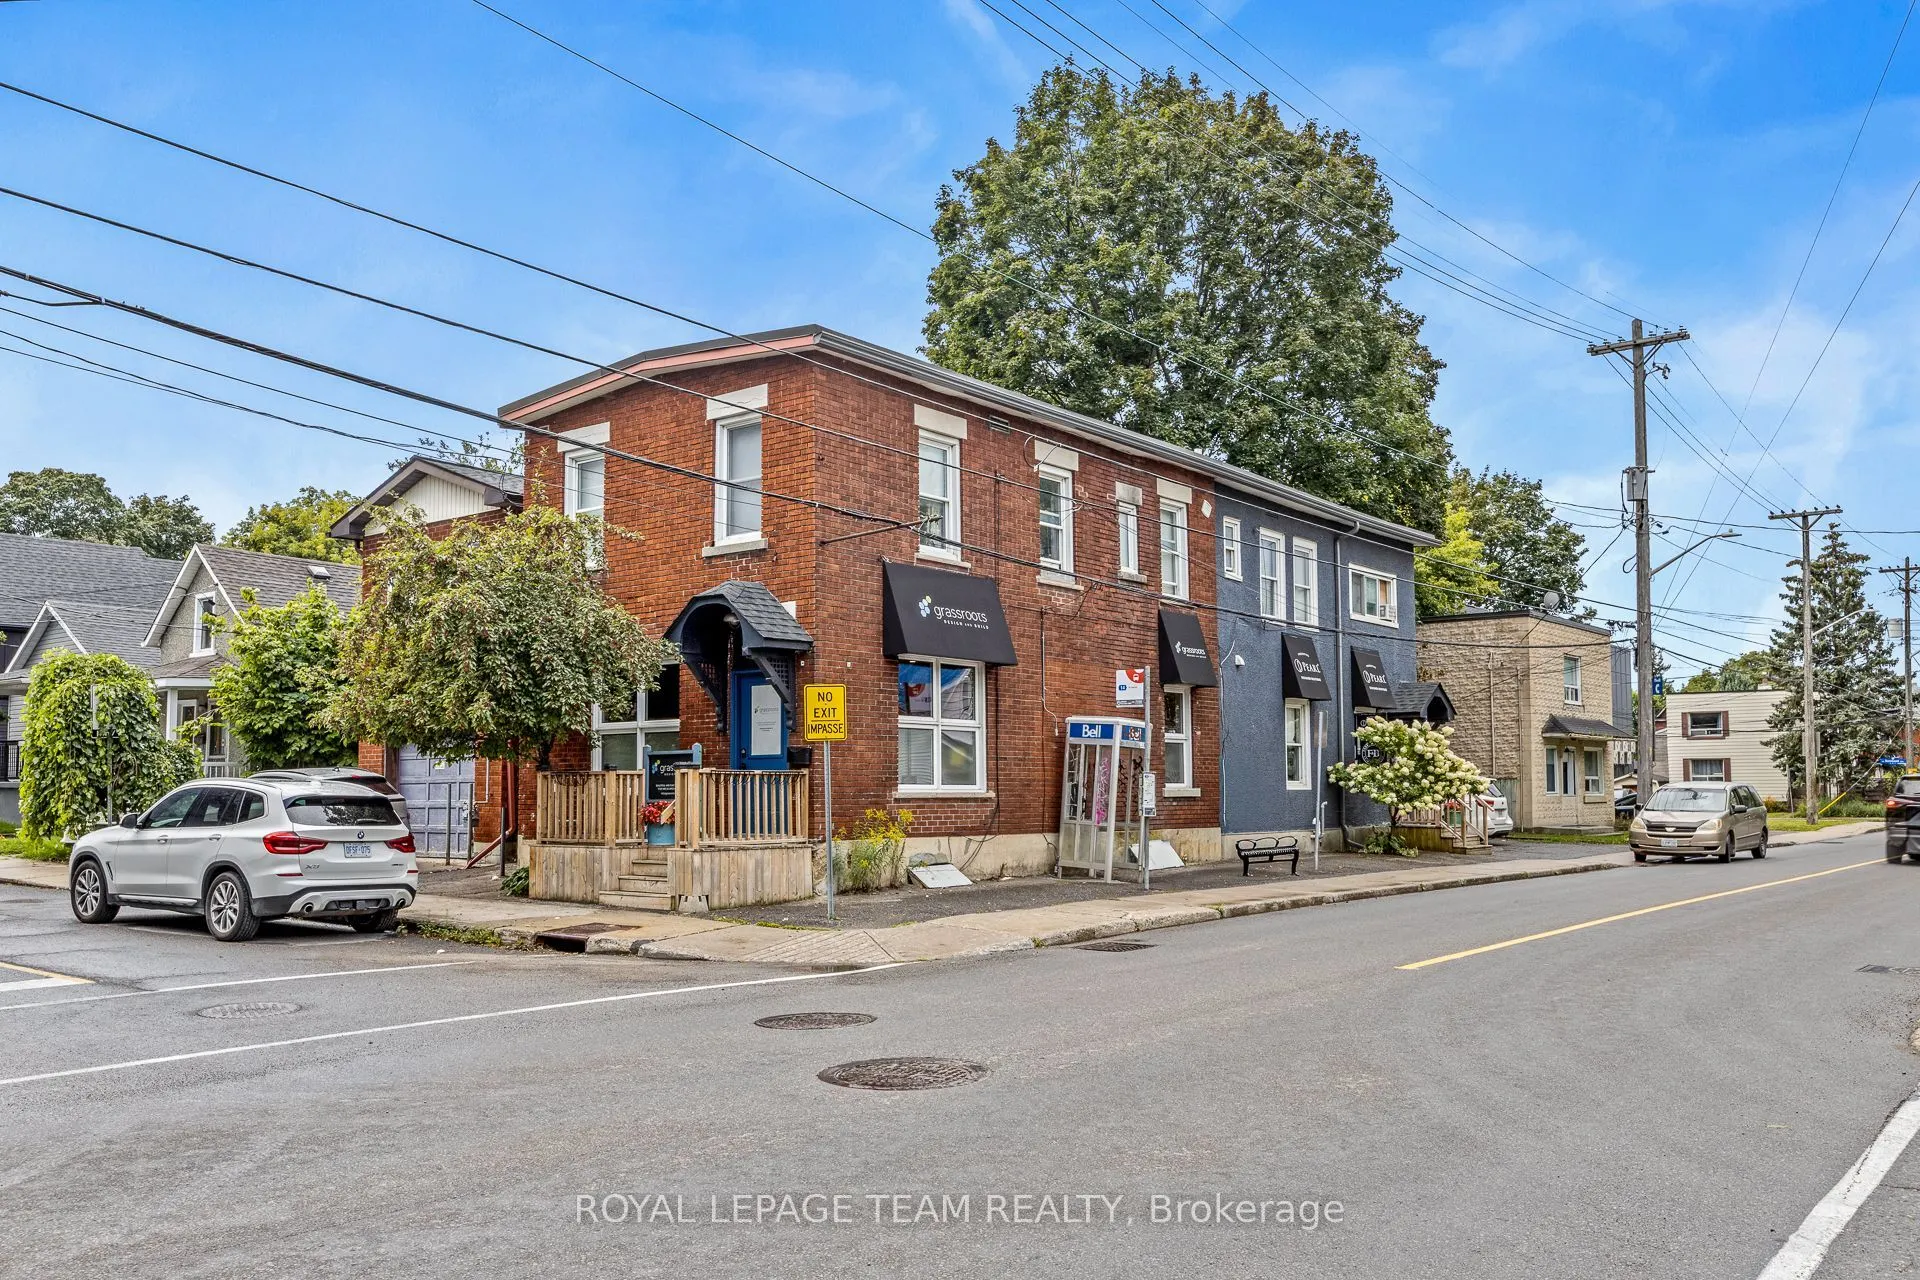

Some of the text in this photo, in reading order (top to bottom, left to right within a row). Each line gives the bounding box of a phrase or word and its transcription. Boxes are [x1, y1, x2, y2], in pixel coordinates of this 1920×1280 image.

[933, 606, 988, 622] grassroots
[817, 691, 833, 702] NO
[813, 707, 837, 718] EXIT
[808, 723, 844, 734] IMPASSE
[1081, 724, 1102, 738] Bell
